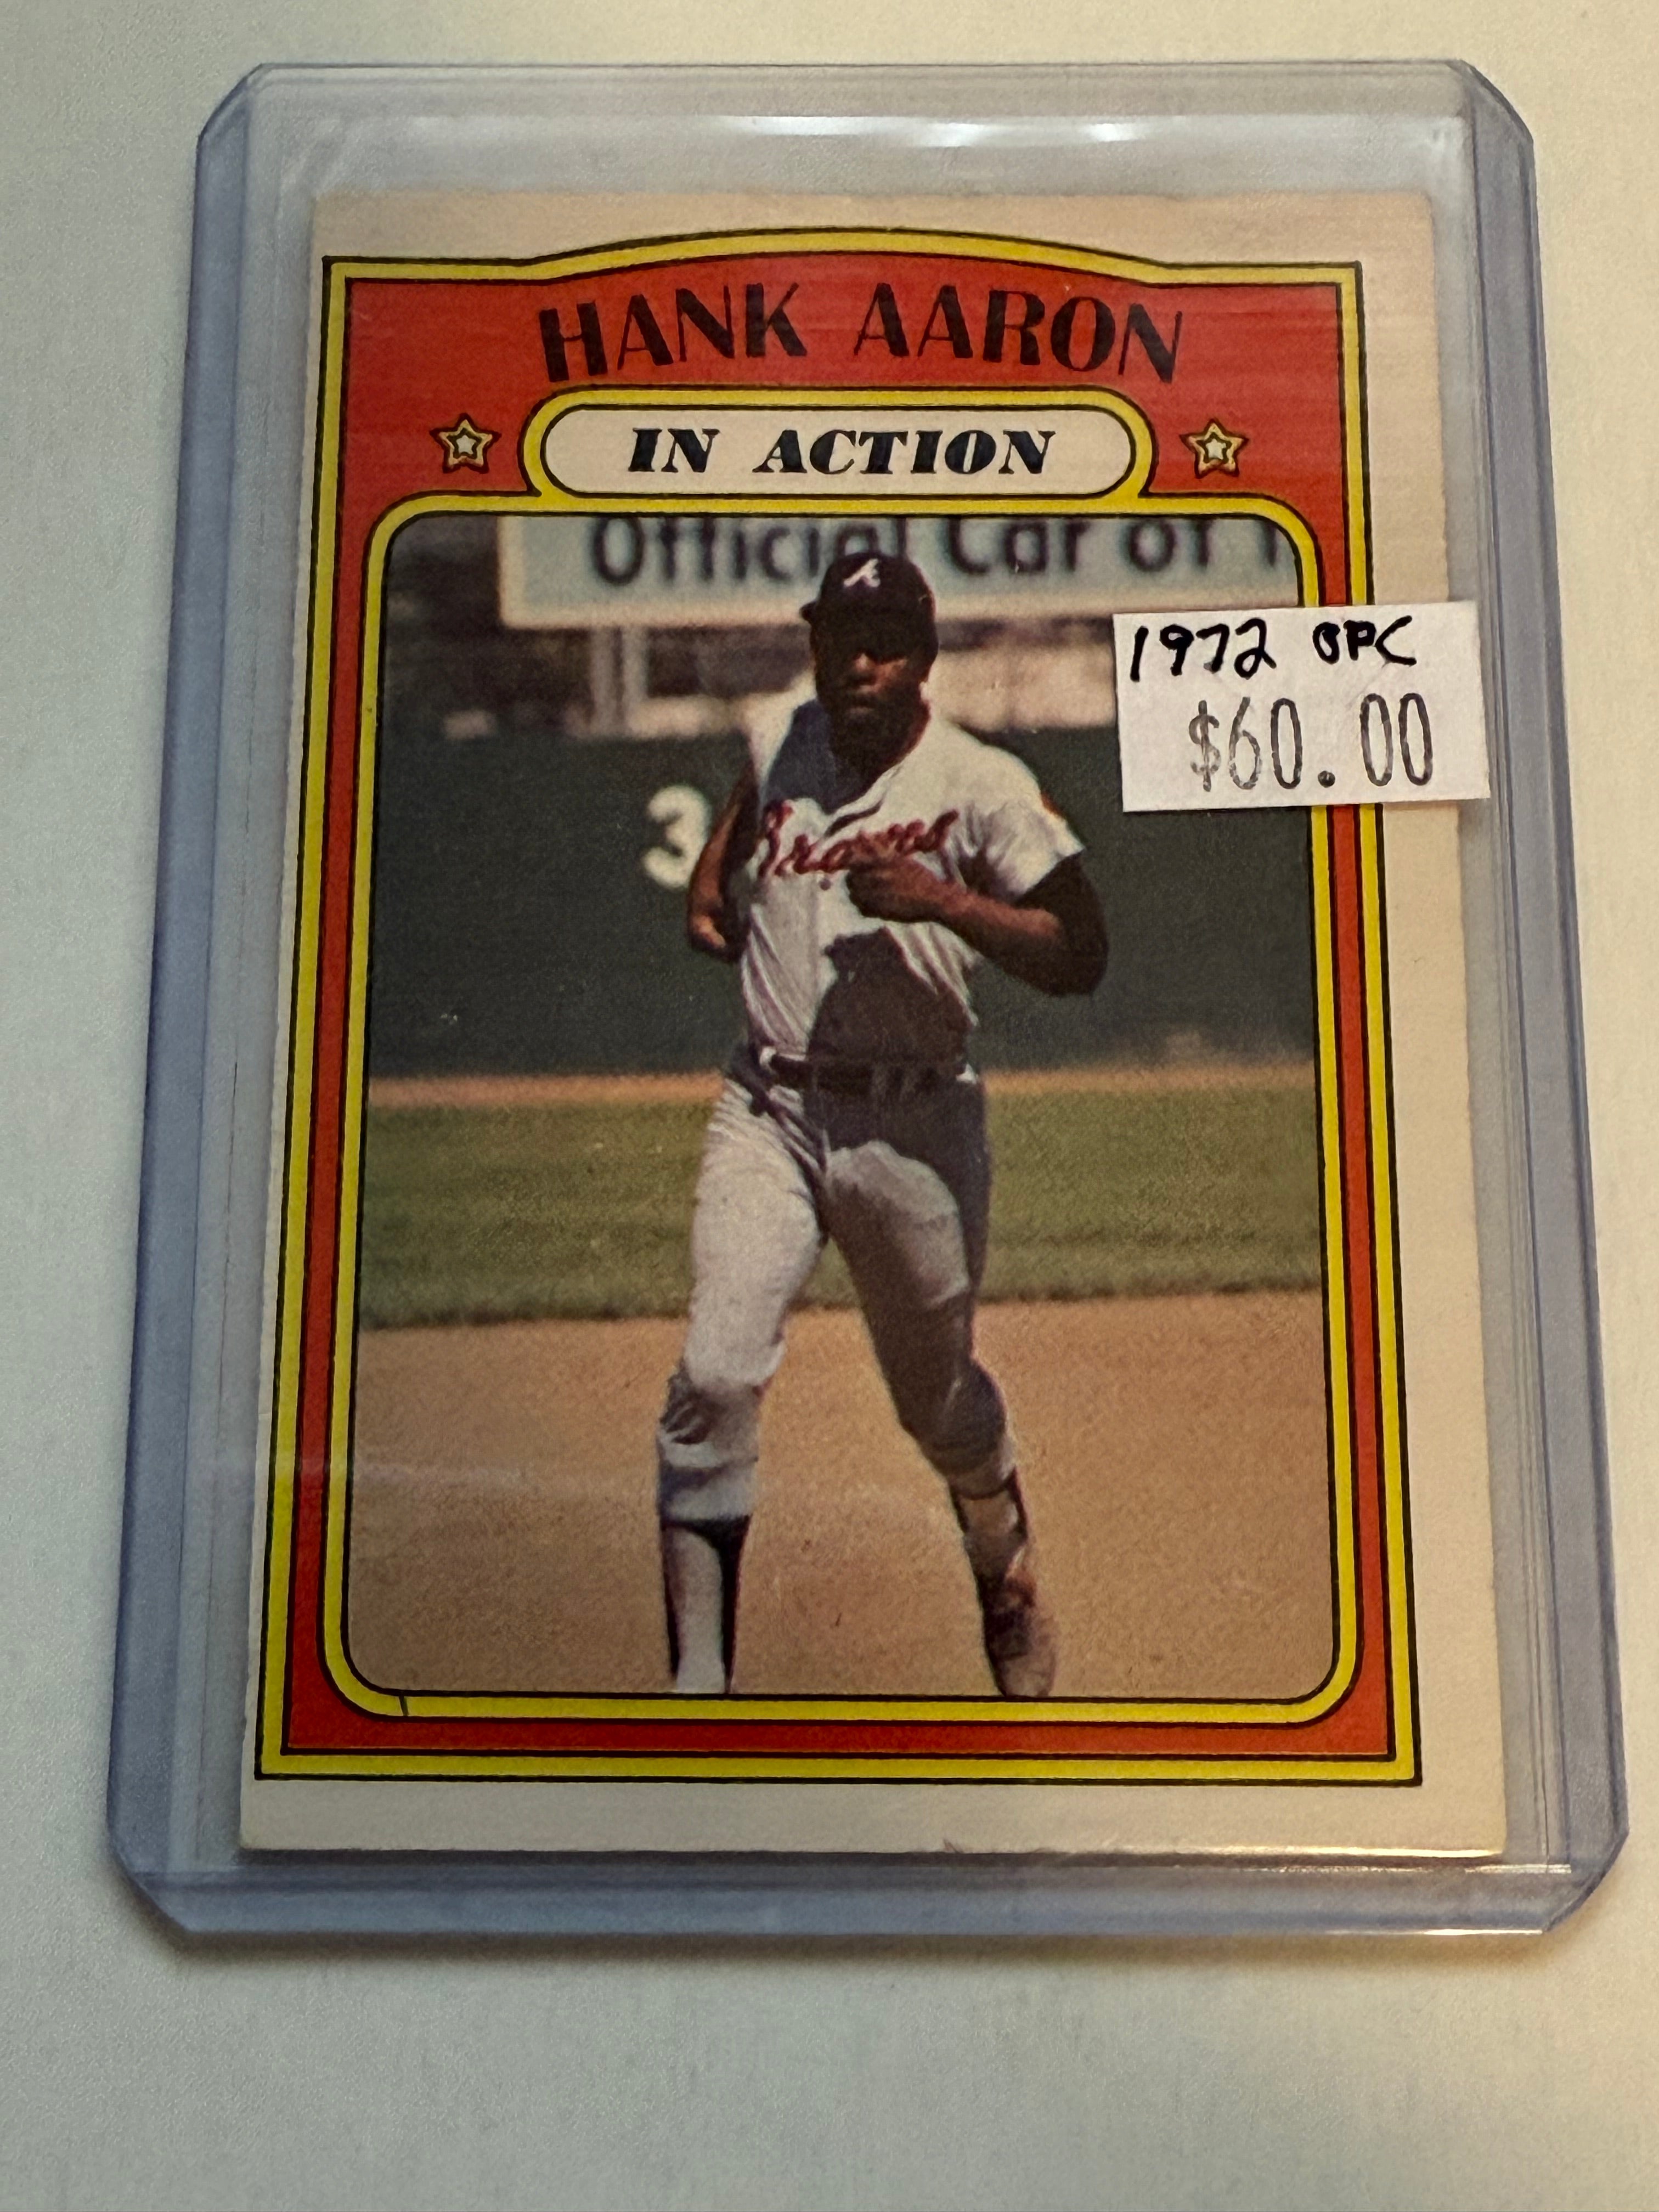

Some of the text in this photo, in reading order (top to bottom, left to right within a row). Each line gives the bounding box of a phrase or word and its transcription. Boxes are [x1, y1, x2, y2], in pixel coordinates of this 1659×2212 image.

[539, 281, 1183, 384] HANK AARON
[628, 427, 1057, 475] IN ACTION
[1129, 617, 1277, 682] 1972
[1188, 692, 1433, 792] $60.00
[643, 785, 707, 888] 3
